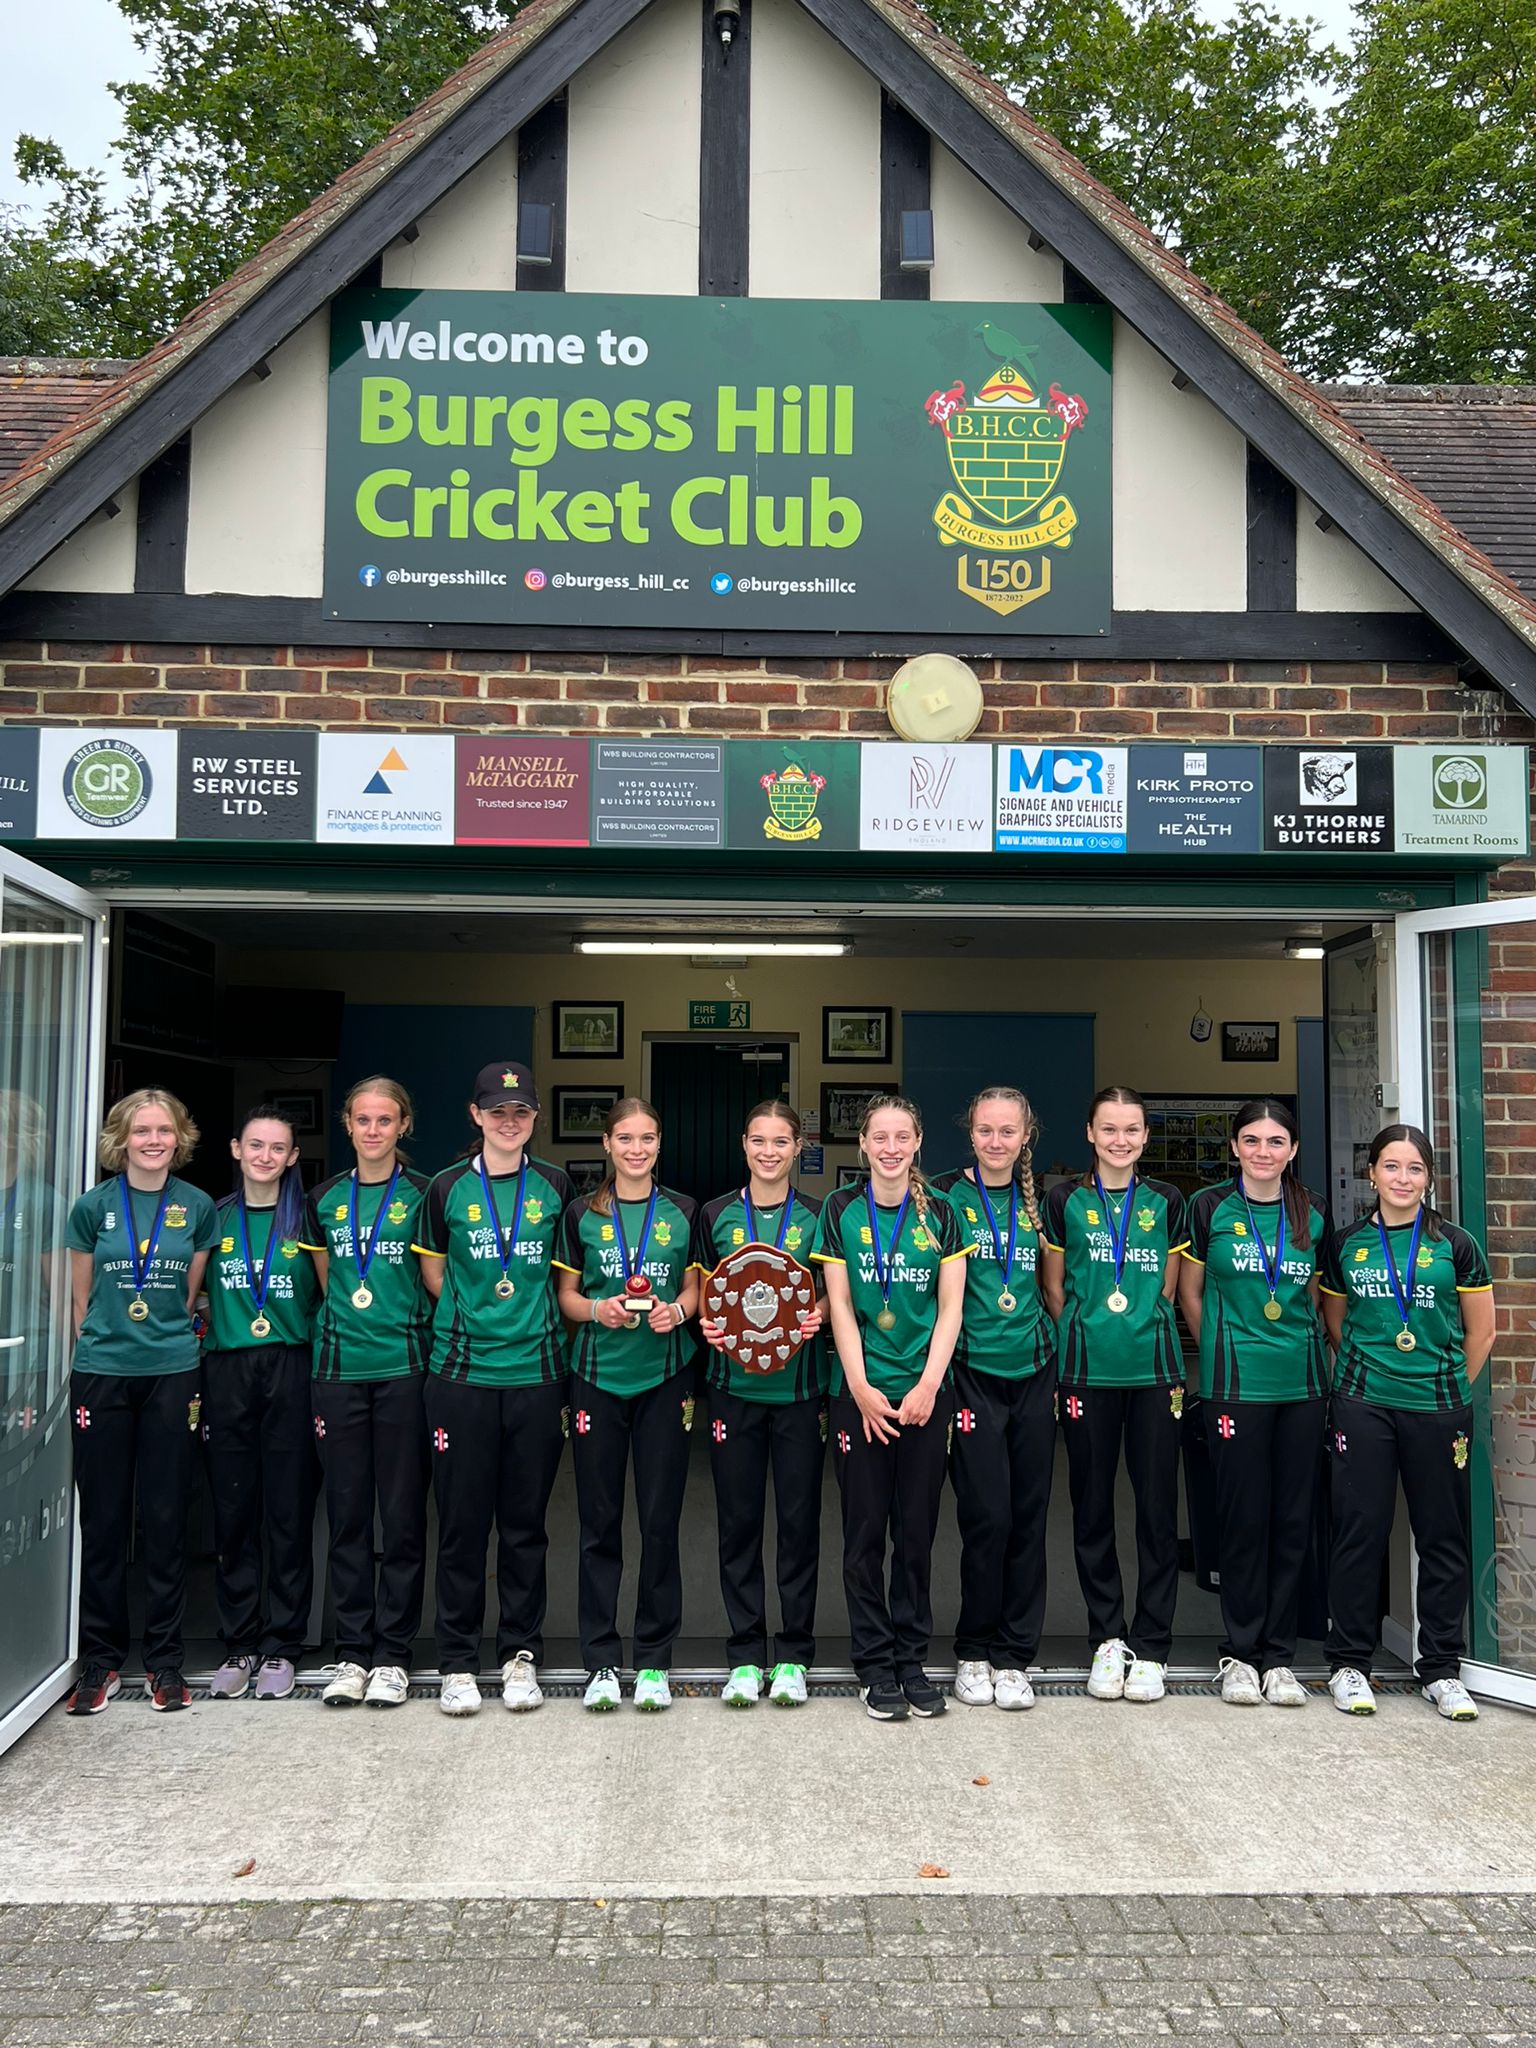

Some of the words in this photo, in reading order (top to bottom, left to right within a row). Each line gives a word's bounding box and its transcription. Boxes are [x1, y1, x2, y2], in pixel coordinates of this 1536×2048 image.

[361, 320, 585, 364] Welcome
[597, 328, 648, 366] to
[360, 376, 693, 466] Burgess
[717, 384, 853, 455] Hill
[956, 414, 1058, 438] B.H.C.C.
[355, 468, 650, 544] Cricket
[670, 475, 862, 548] Club
[939, 512, 1004, 546] BURGESS
[1008, 532, 1045, 546] HILL
[1045, 516, 1074, 537] C.C.
[386, 567, 507, 588] @burgesshillcc
[976, 559, 1032, 590] 150
[551, 572, 690, 592] @burgess_hill_cc
[737, 576, 857, 596] @burgesshillcc
[985, 593, 1024, 602] 1872-2022
[73, 740, 102, 763] GREEN
[104, 740, 111, 749] &
[114, 741, 145, 764] RIDLEY
[621, 751, 657, 759] BUILDING
[659, 751, 715, 760] CONTRACTORS
[192, 757, 229, 773] RW
[234, 757, 302, 776] STEEL
[476, 755, 568, 773] MANSELL
[1009, 748, 1104, 794] MCR
[83, 763, 131, 793] GR
[465, 771, 579, 789] McTAGGART
[1106, 763, 1116, 795] media
[192, 777, 299, 796] SERVICES
[650, 781, 698, 789] QUALITY,
[773, 784, 814, 794] B.H.C.C.
[1137, 779, 1180, 791] KIRK
[1190, 780, 1254, 792] PROTO
[85, 792, 129, 802] Teamwear
[624, 790, 692, 798] AFFORDABLE
[1148, 796, 1242, 804] PHYSIOTHERAPIST
[222, 798, 268, 816] LTD.
[476, 798, 515, 809] Trusted
[515, 799, 542, 809] since
[543, 799, 568, 809] 1947
[600, 798, 651, 806] BUILDING
[657, 799, 716, 807] SOLUTIONS
[999, 797, 1047, 811] SIGNAGE
[1051, 798, 1074, 812] AND
[1077, 799, 1123, 813] VEHICLE
[66, 793, 84, 817] SPORTS
[83, 811, 114, 827] CLOTHING
[119, 795, 148, 825] EQUIPMENT
[327, 809, 379, 821] FINANCE
[381, 810, 442, 822] PLANNING
[999, 812, 1052, 827] GRAPHICS
[1055, 814, 1123, 828] SPECIALISTS
[1184, 813, 1207, 821] THE
[1273, 814, 1296, 829] KJ
[1304, 815, 1386, 829] THORNE
[1432, 813, 1488, 825] TAMARIND
[327, 821, 381, 833] mortgages
[382, 822, 388, 831] &
[390, 821, 442, 833] protection
[620, 823, 657, 831] BUILDING
[658, 823, 715, 831] CONTRACTORS
[872, 818, 985, 831] RIDGEVIEW
[1159, 823, 1232, 835] HEALTH
[999, 835, 1084, 847] WWW.MCRMEDIA.CO.UK
[1183, 838, 1207, 846] HUB
[1278, 830, 1381, 844] BUTCHERS
[1402, 832, 1469, 845] Treatment
[1473, 833, 1519, 845] Rooms
[693, 1005, 717, 1014] FIRE
[693, 1016, 716, 1025] EXIT
[469, 1241, 543, 1260] WELNESS
[1089, 1248, 1158, 1263] WELNESS
[164, 1260, 188, 1272] HILL
[1021, 1262, 1036, 1271] HUB
[1141, 1263, 1158, 1272] HUB
[1232, 1258, 1311, 1276] WELNESS
[220, 1274, 293, 1290] WELESS
[275, 1289, 294, 1298] HUB
[1416, 1299, 1435, 1308] HUB
